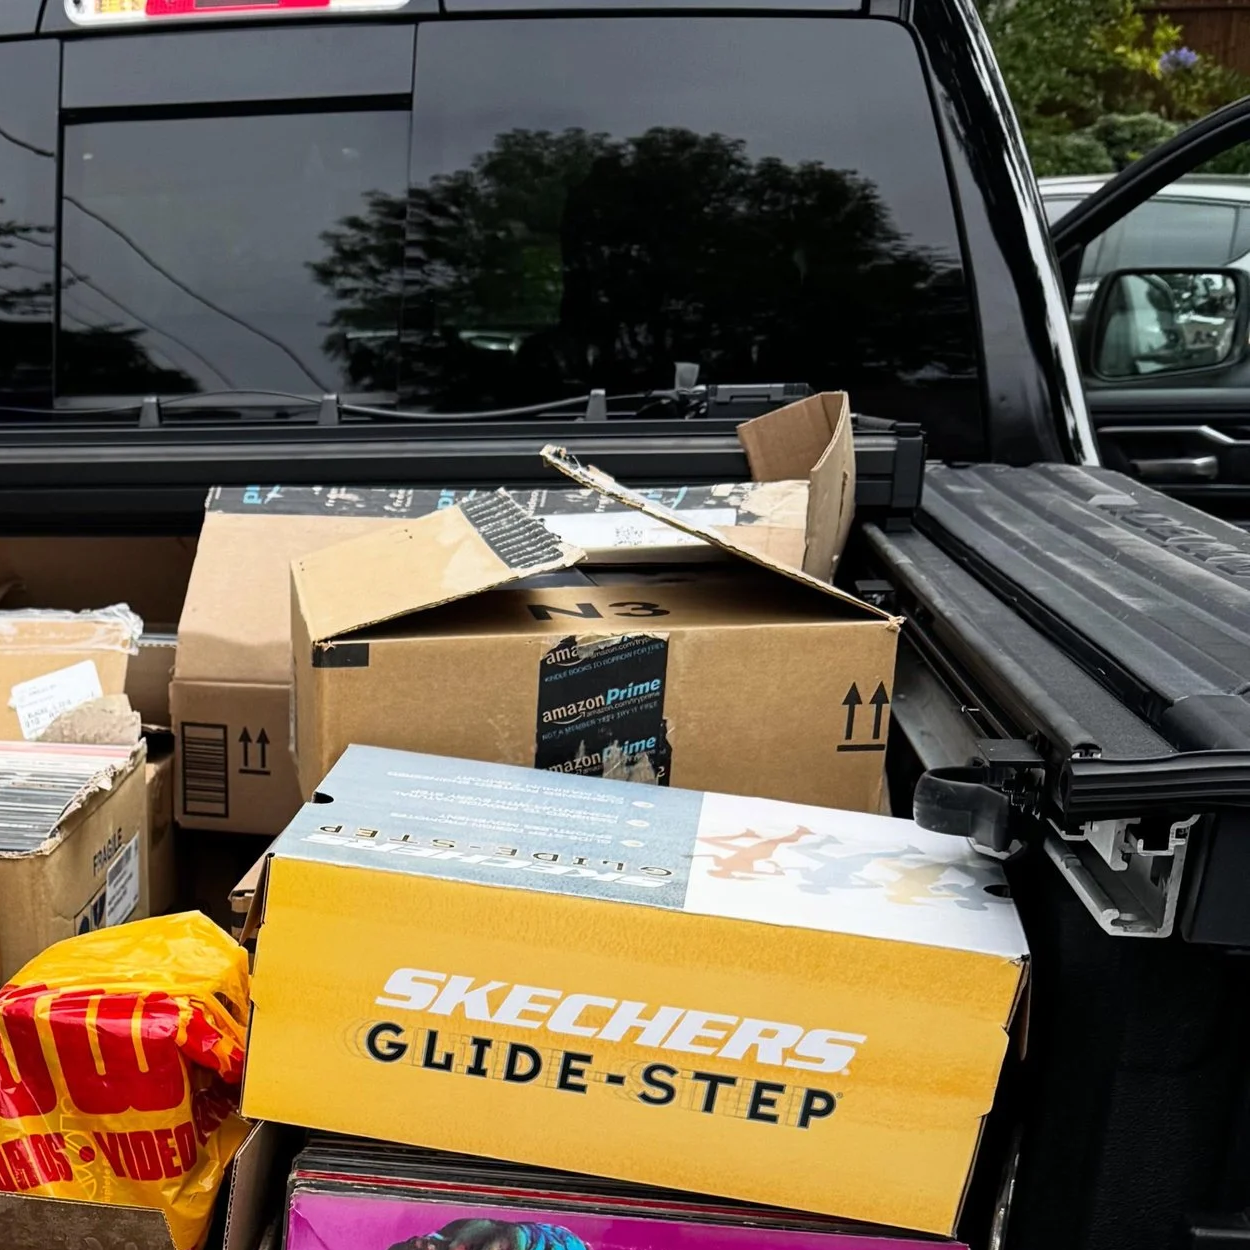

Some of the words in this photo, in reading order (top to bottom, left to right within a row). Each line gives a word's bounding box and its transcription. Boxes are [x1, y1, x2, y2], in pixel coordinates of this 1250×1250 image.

[374, 967, 867, 1074] SKECHERS
[365, 1021, 840, 1130] GLIDE-STEP
[94, 1121, 198, 1182] VIDEO
